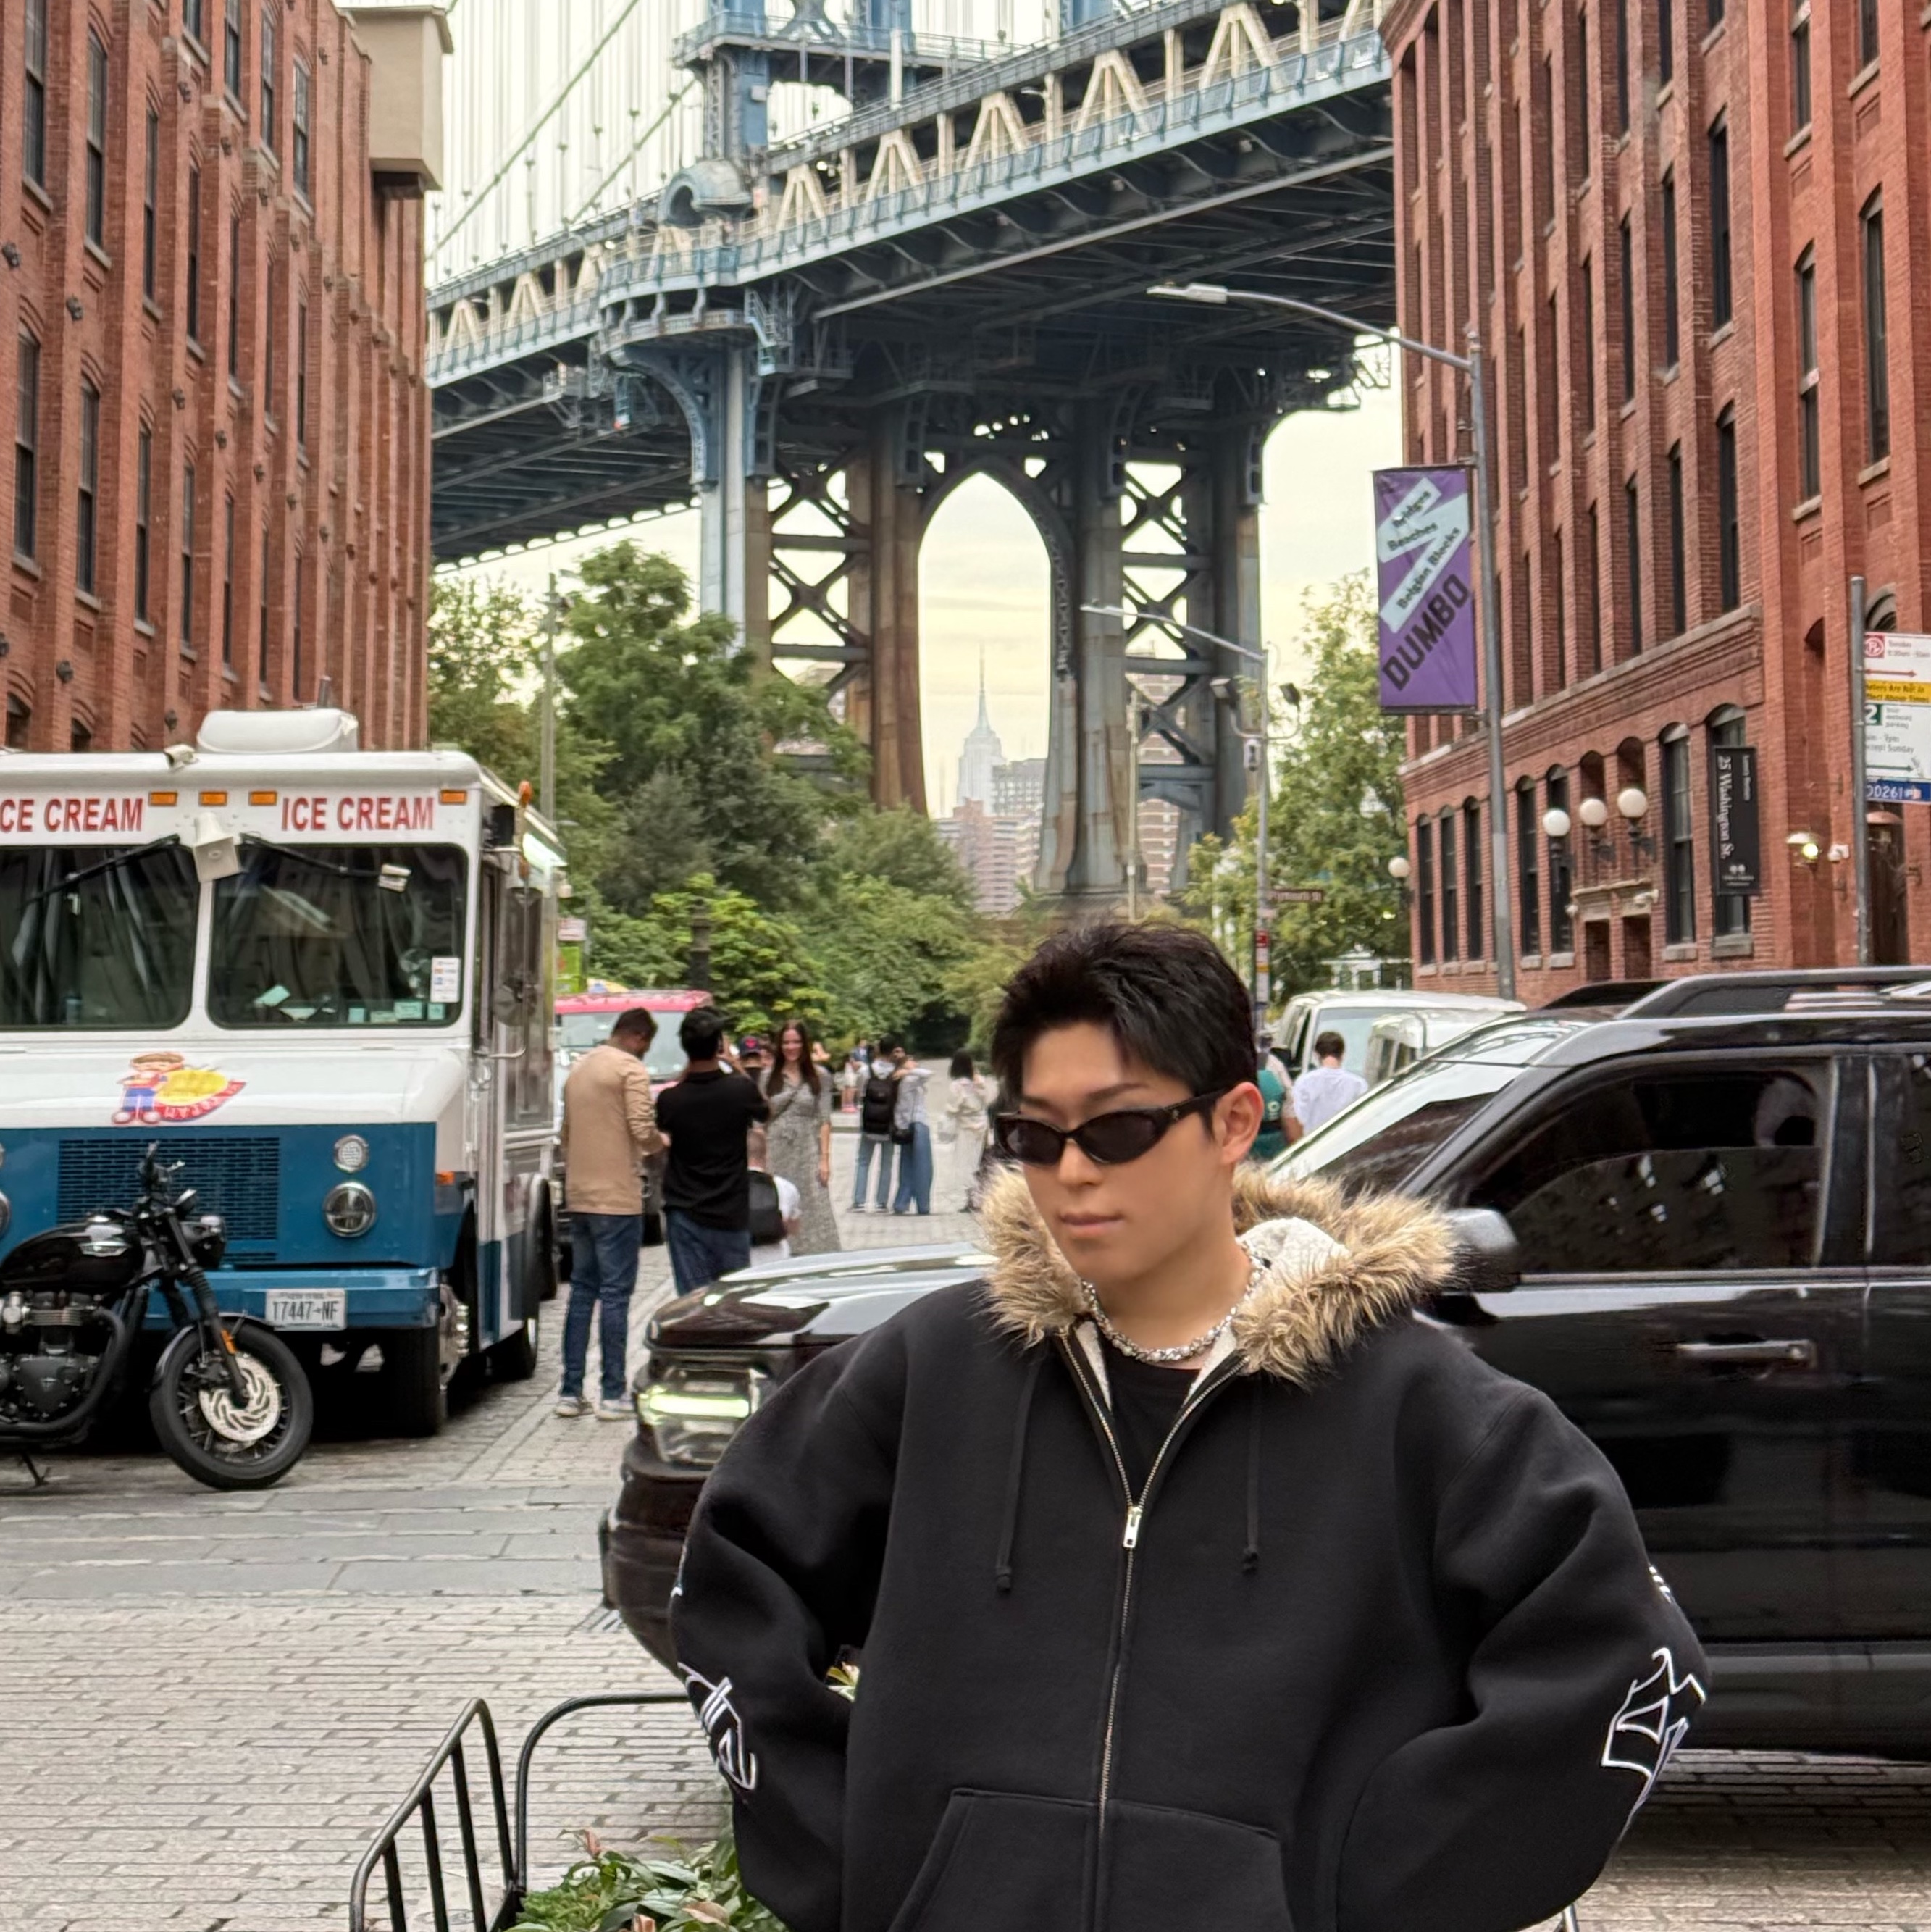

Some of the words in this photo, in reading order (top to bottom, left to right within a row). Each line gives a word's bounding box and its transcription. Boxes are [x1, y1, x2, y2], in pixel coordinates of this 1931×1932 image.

[1381, 574, 1470, 692] DUMBO
[1864, 704, 1878, 724] 2
[1717, 755, 1732, 771] 25
[0, 798, 35, 834] CE
[43, 798, 143, 833] CREAM
[281, 797, 328, 832] ICE
[336, 797, 435, 832] CREAM
[1717, 772, 1733, 842] Washington
